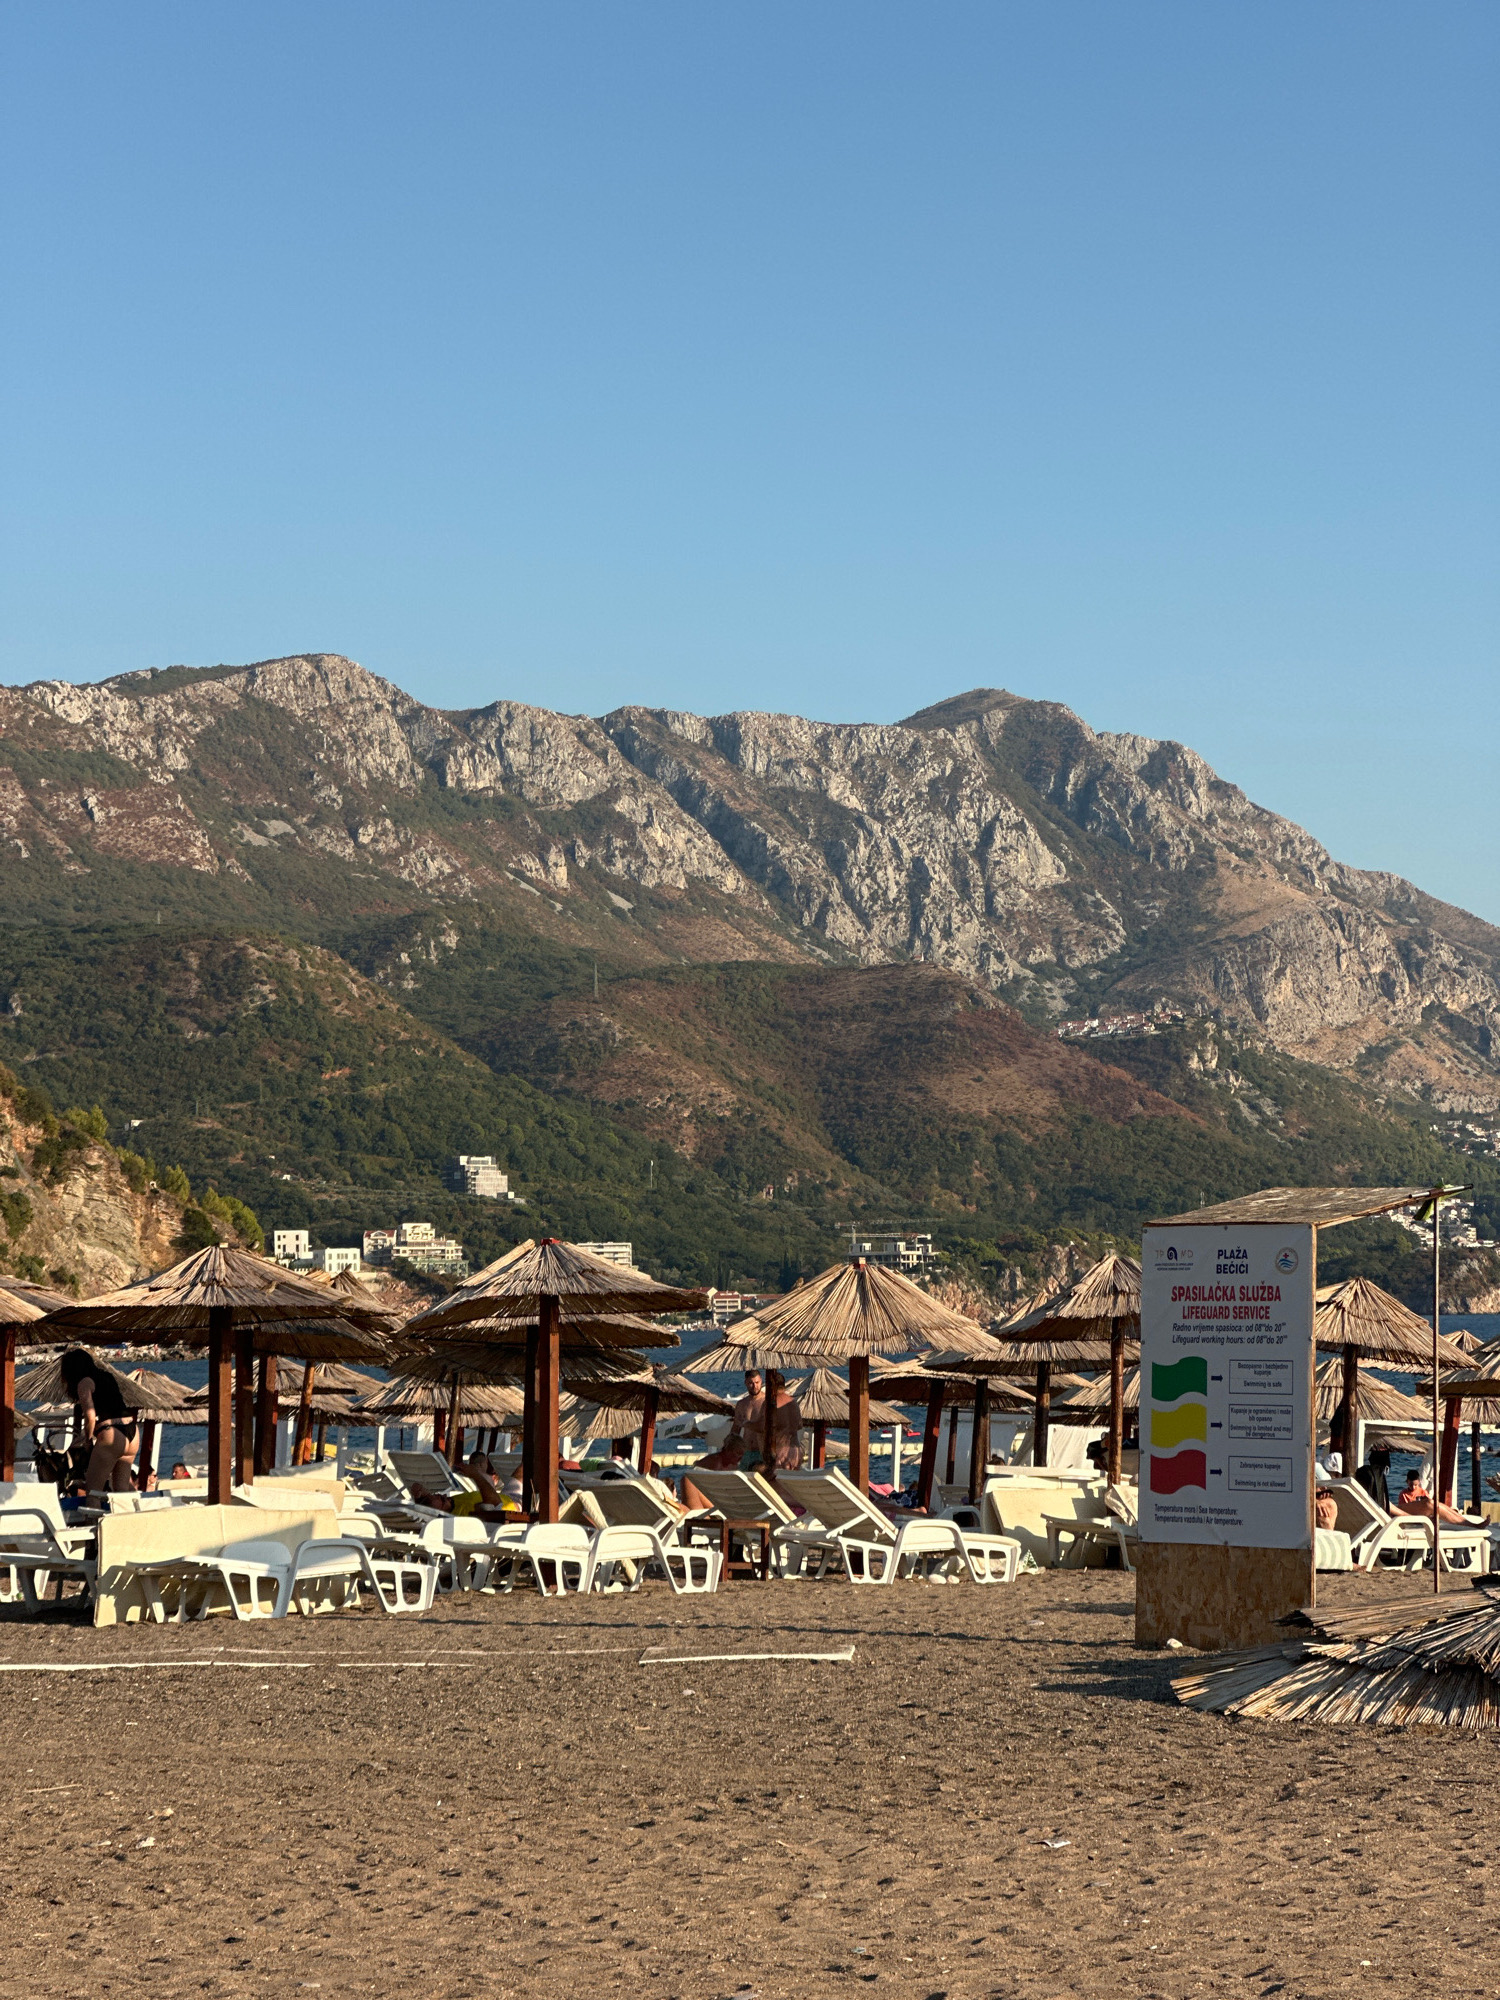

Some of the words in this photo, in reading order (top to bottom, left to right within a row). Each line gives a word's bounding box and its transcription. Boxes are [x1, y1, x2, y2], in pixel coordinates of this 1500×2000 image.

[1217, 1246, 1248, 1259] PLAŽA
[1171, 1281, 1236, 1302] SPASILAČKA
[1239, 1281, 1281, 1302] SLUŽBA
[1182, 1305, 1230, 1320] LIFEGUARD
[1232, 1305, 1271, 1320] SERVICE
[1172, 1323, 1191, 1331] Radno
[1193, 1323, 1214, 1334] vrijeme
[1215, 1323, 1243, 1334] spasioca:
[1245, 1323, 1253, 1332] od
[1172, 1335, 1200, 1345] Lifeguard
[1201, 1335, 1225, 1345] working
[1226, 1335, 1246, 1344] hours:
[1247, 1335, 1255, 1344] od
[1244, 1380, 1266, 1388] Swimming
[1235, 1479, 1256, 1487] Swimming
[1154, 1503, 1183, 1513] Temperatura
[1199, 1505, 1208, 1513] Sea
[1154, 1513, 1183, 1524] Temperatura
